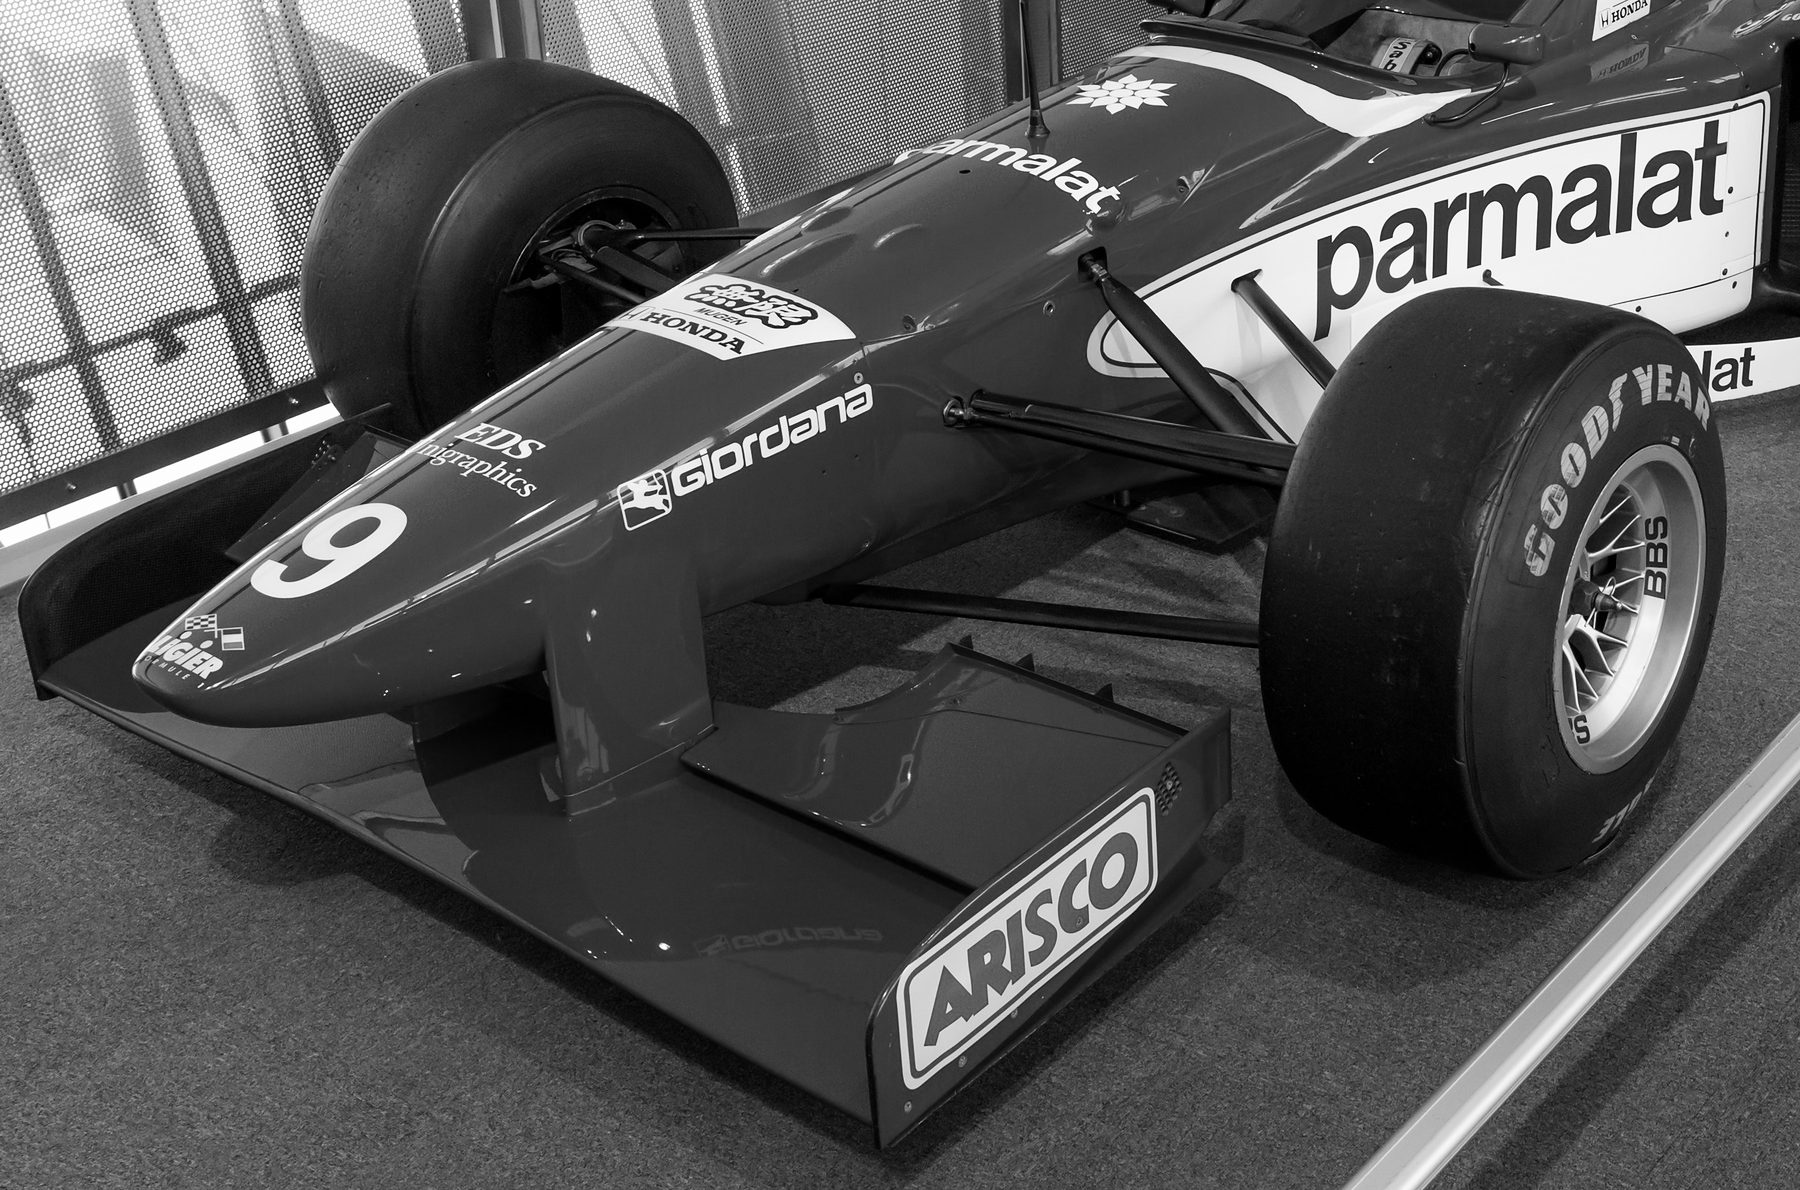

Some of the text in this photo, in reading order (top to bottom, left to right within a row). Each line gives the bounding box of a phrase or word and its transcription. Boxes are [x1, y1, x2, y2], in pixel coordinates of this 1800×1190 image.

[1611, 0, 1648, 23] HONDA
[1313, 120, 1727, 342] parmalat
[640, 312, 747, 354] HONDA
[694, 306, 747, 326] MUGEN
[454, 422, 546, 459] EDS
[250, 503, 408, 599] 9
[1644, 515, 1668, 599] BBS
[924, 831, 1139, 1047] ARISCO
